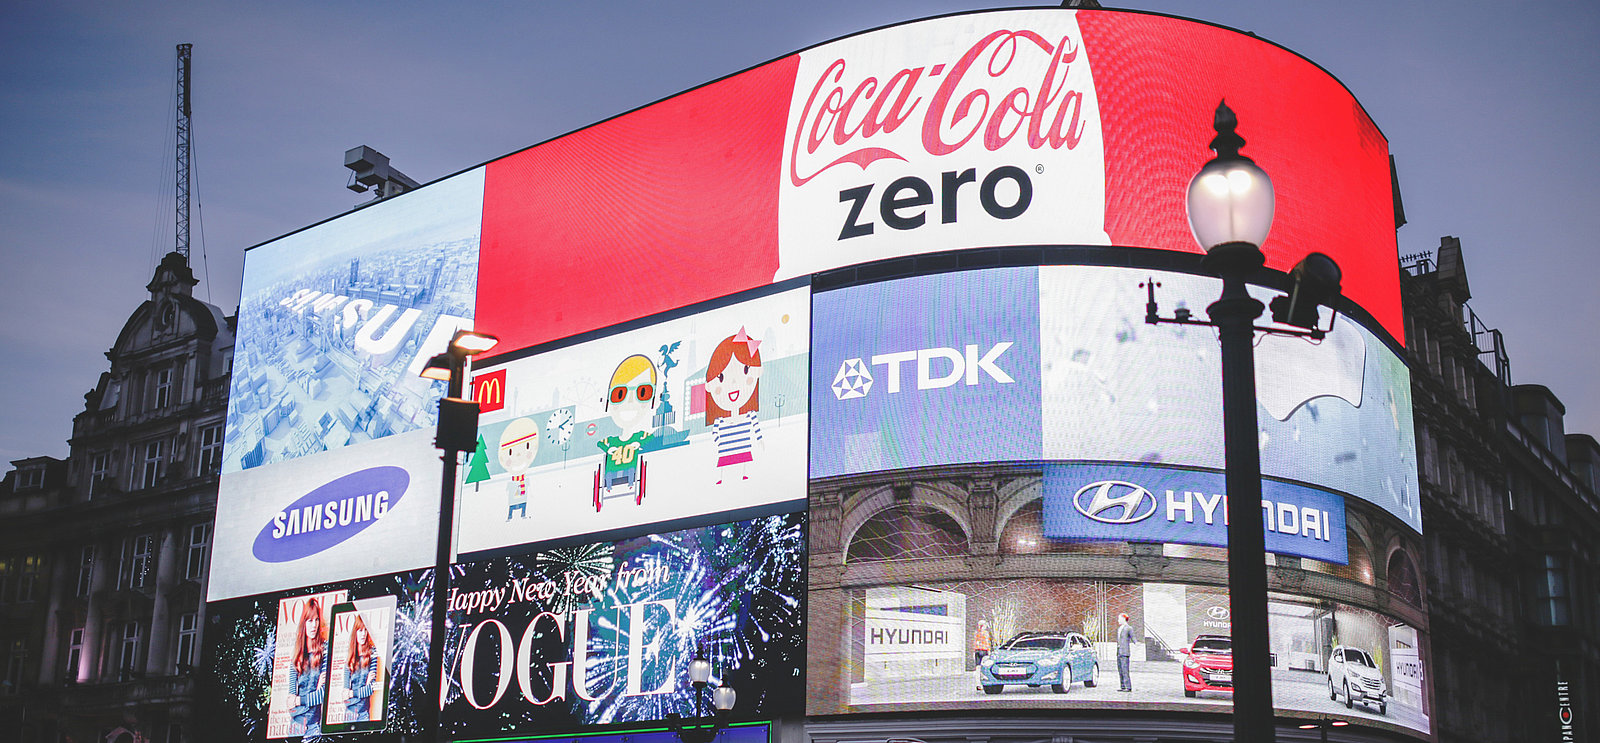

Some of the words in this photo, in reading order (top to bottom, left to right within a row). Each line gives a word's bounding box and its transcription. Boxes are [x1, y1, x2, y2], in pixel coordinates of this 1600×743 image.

[790, 29, 1086, 187] Coca-Cola
[837, 164, 1034, 242] zero
[871, 340, 1015, 394] TDK
[610, 444, 636, 466] 40
[272, 490, 389, 540] SAMSUNG
[1165, 489, 1331, 542] HYNDAI
[508, 577, 557, 605] New
[563, 570, 611, 597] Year
[614, 560, 671, 595] from
[870, 627, 949, 646] HYUNDAI
